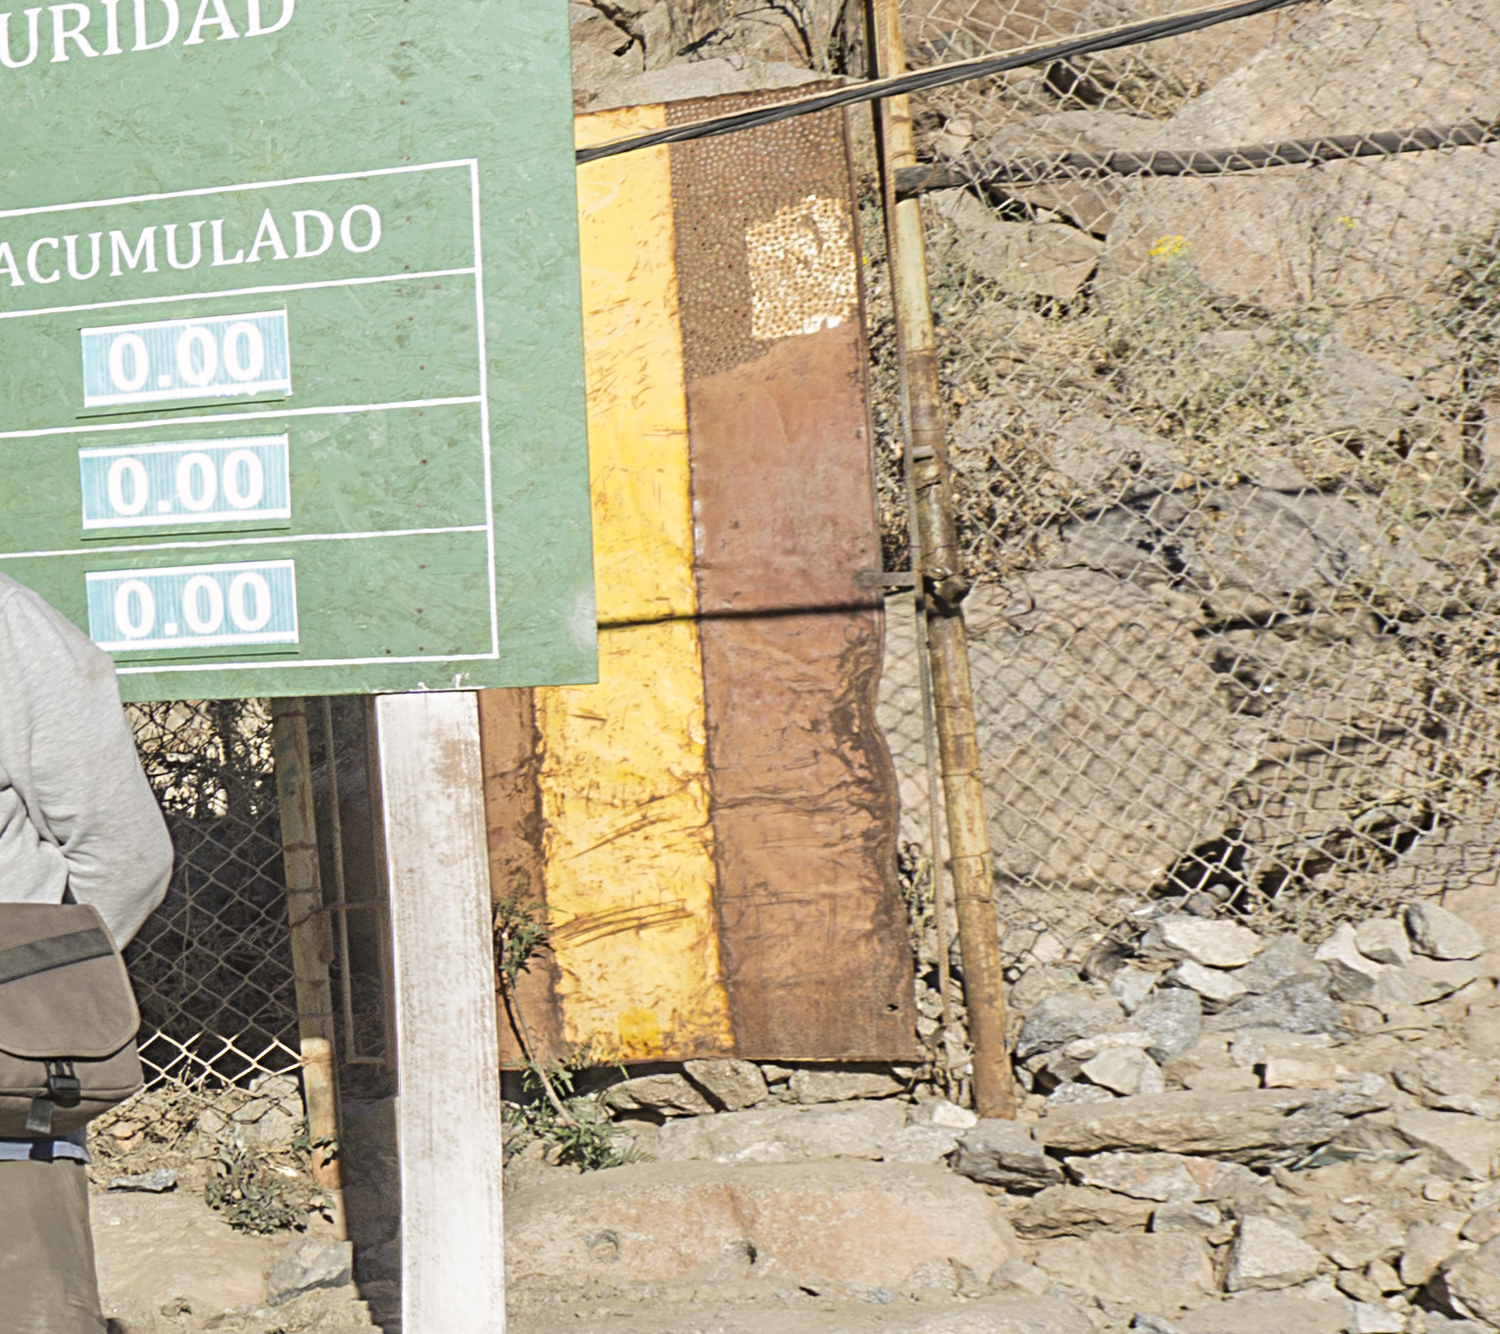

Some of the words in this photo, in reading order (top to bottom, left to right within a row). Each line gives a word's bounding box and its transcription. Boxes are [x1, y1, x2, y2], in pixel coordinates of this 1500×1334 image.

[109, 322, 264, 391] 0.00
[107, 449, 265, 516] 0.00
[113, 572, 272, 638] 0.00
